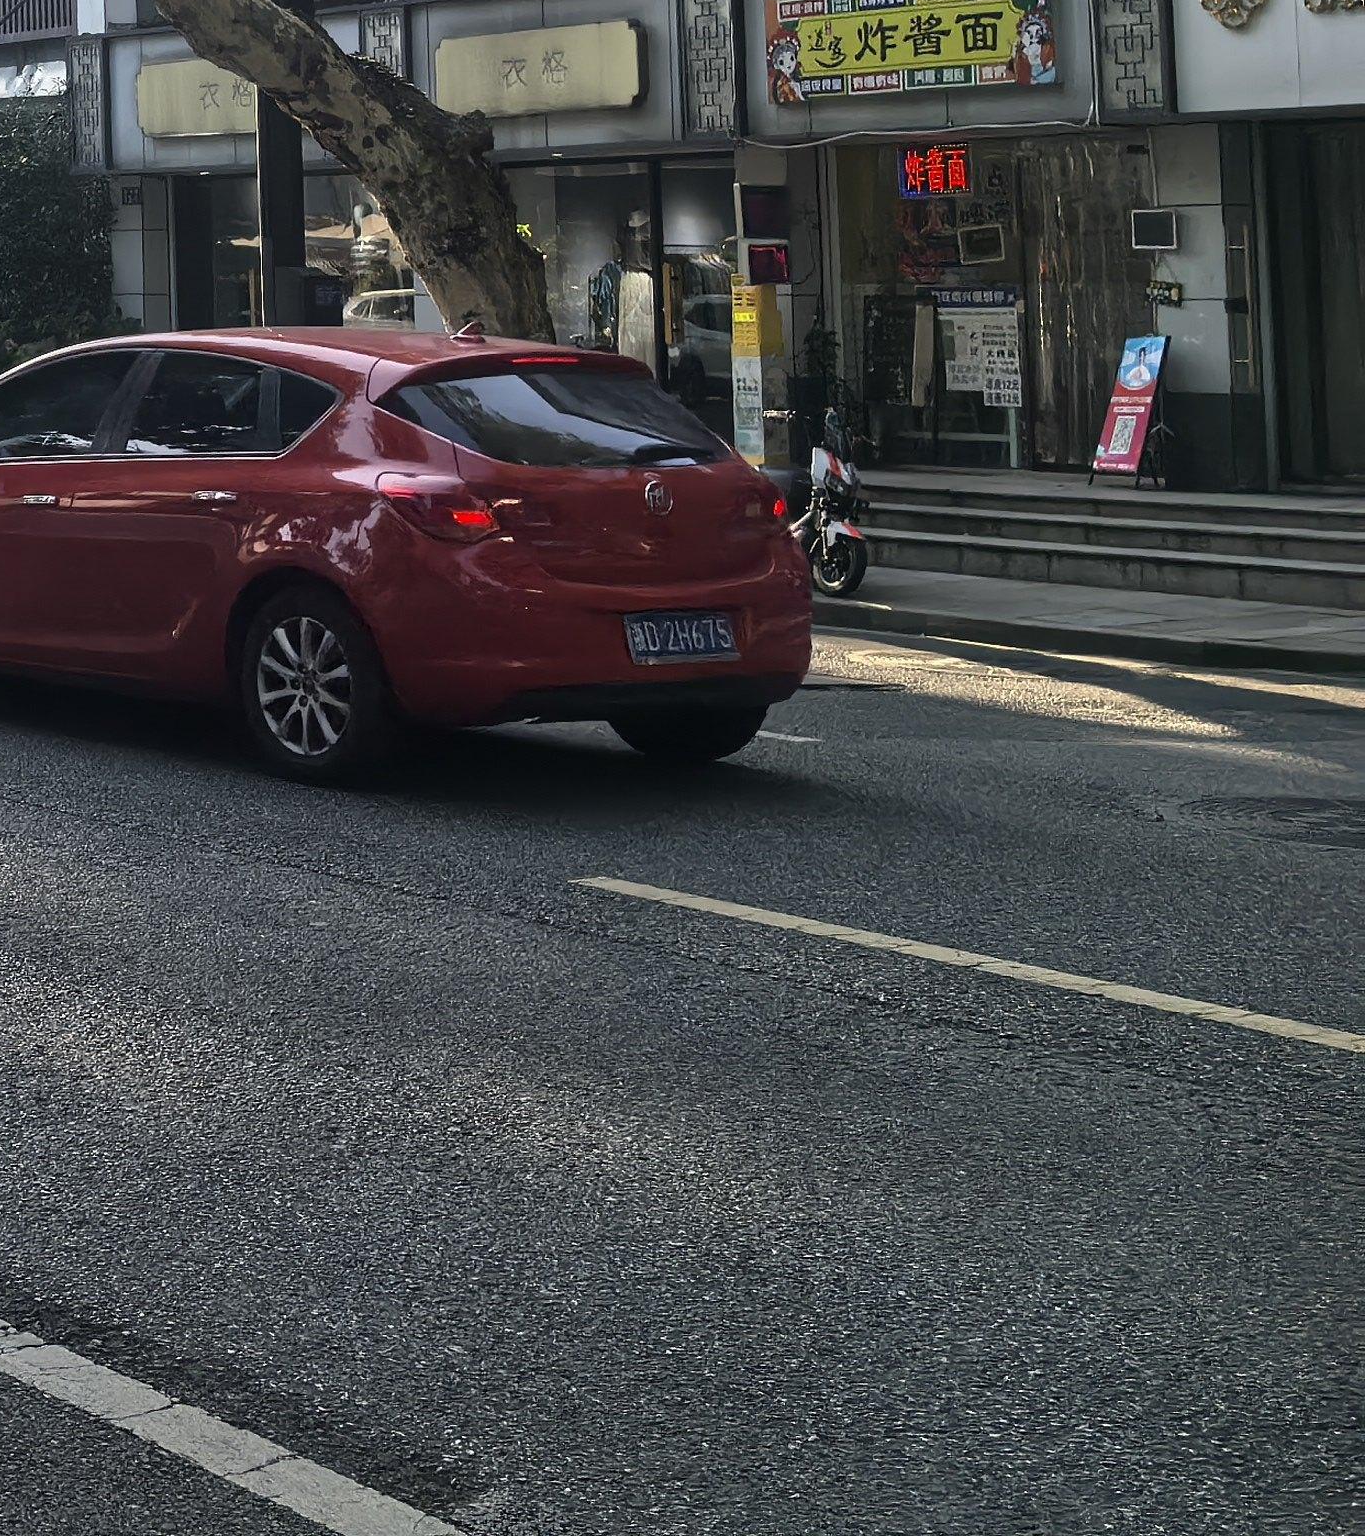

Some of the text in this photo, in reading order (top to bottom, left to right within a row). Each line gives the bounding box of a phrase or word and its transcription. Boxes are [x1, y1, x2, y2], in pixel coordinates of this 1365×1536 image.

[854, 12, 1003, 62] 炸酱面
[501, 51, 567, 90] 衣格
[905, 149, 967, 193] 炸酱面
